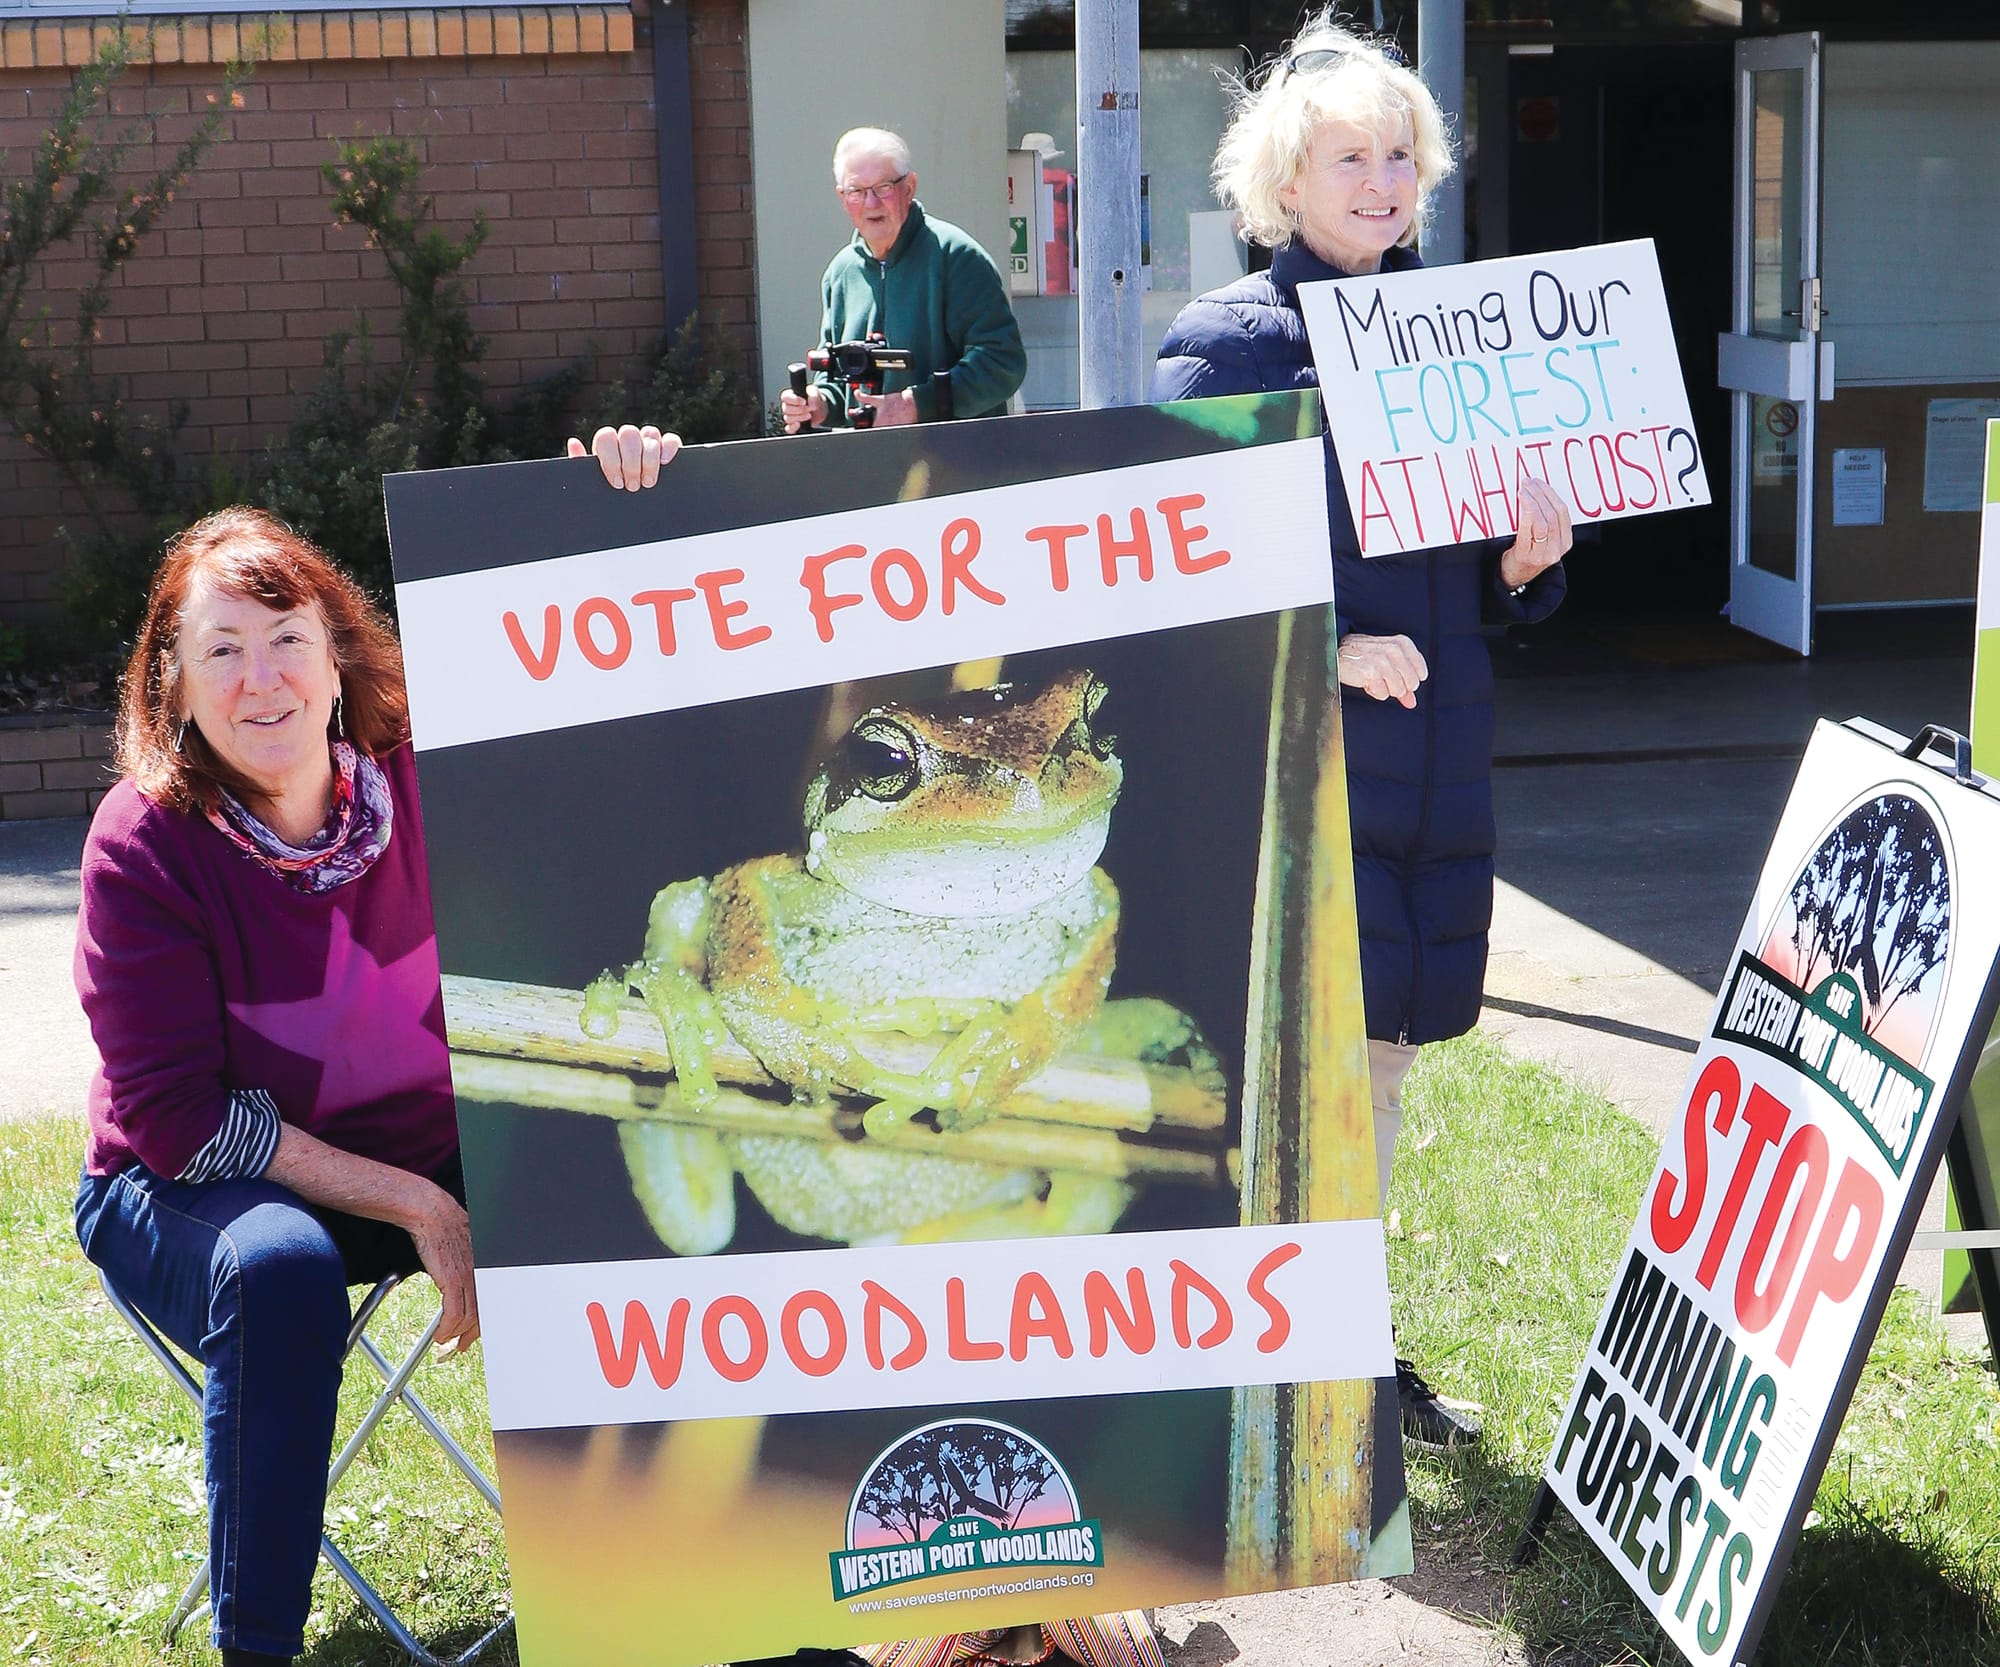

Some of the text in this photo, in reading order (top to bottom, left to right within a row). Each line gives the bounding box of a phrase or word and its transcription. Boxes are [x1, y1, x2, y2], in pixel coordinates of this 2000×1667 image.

[1334, 270, 1631, 371] Mining Our
[1361, 456, 1424, 552] AT
[1564, 425, 1699, 518] COST?
[1776, 440, 1787, 453] NO
[503, 494, 1230, 680] VOTE FOR THE
[1723, 966, 1924, 1161] WESTERN PORT WOODLANDS
[1826, 982, 1856, 1019] SAVE
[1650, 1056, 1884, 1367] STOP
[587, 1243, 1301, 1389] WOODLANDS
[1598, 1248, 1777, 1502] MINING
[838, 1526, 1095, 1594] WESTERN PORT WOODLANDS
[949, 1521, 980, 1538] SAVE
[1556, 1367, 1753, 1656] FORESTS
[849, 1573, 1094, 1614] www.savewesternportwoodlands.org
